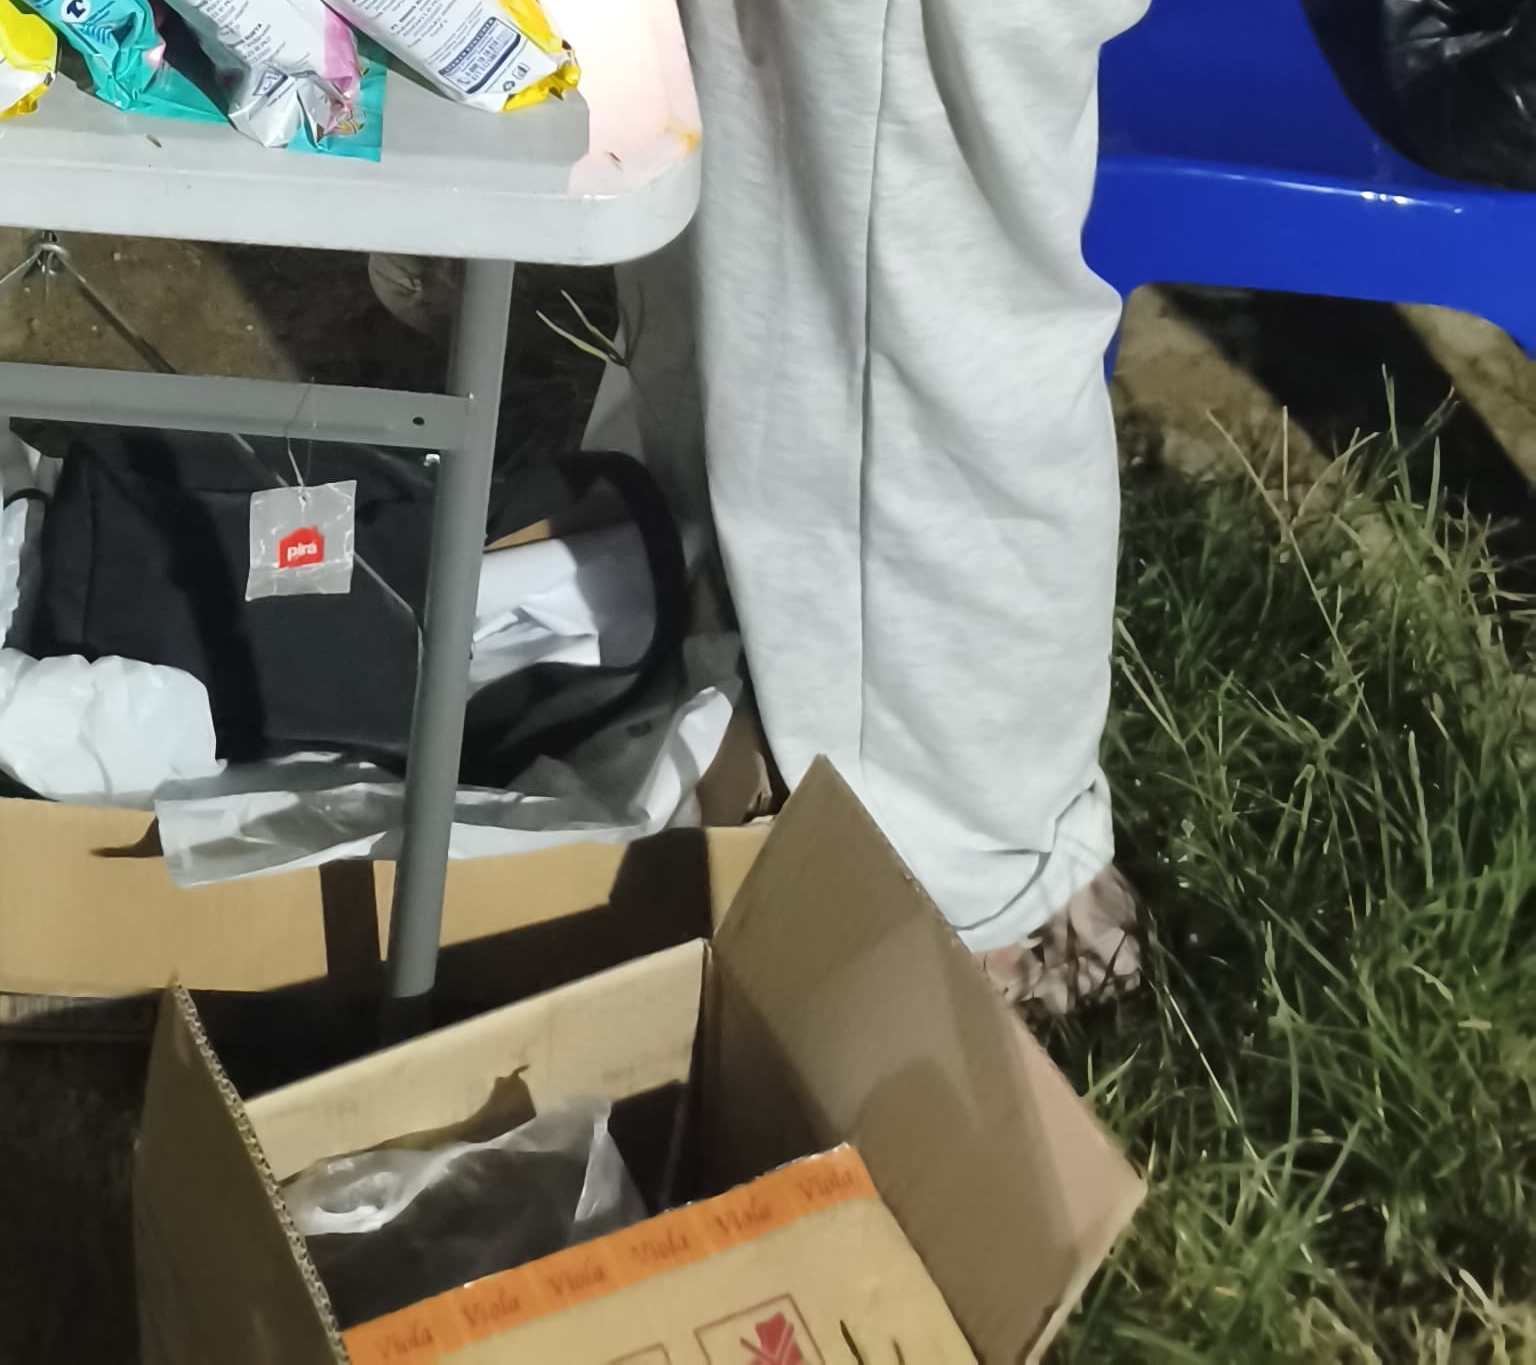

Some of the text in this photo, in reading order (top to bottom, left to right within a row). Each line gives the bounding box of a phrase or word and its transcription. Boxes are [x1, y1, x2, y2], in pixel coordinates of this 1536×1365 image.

[458, 1293, 525, 1325] Viola
[546, 1263, 609, 1294] Viola
[712, 1203, 776, 1234] Viola
[795, 1167, 859, 1200] Viola
